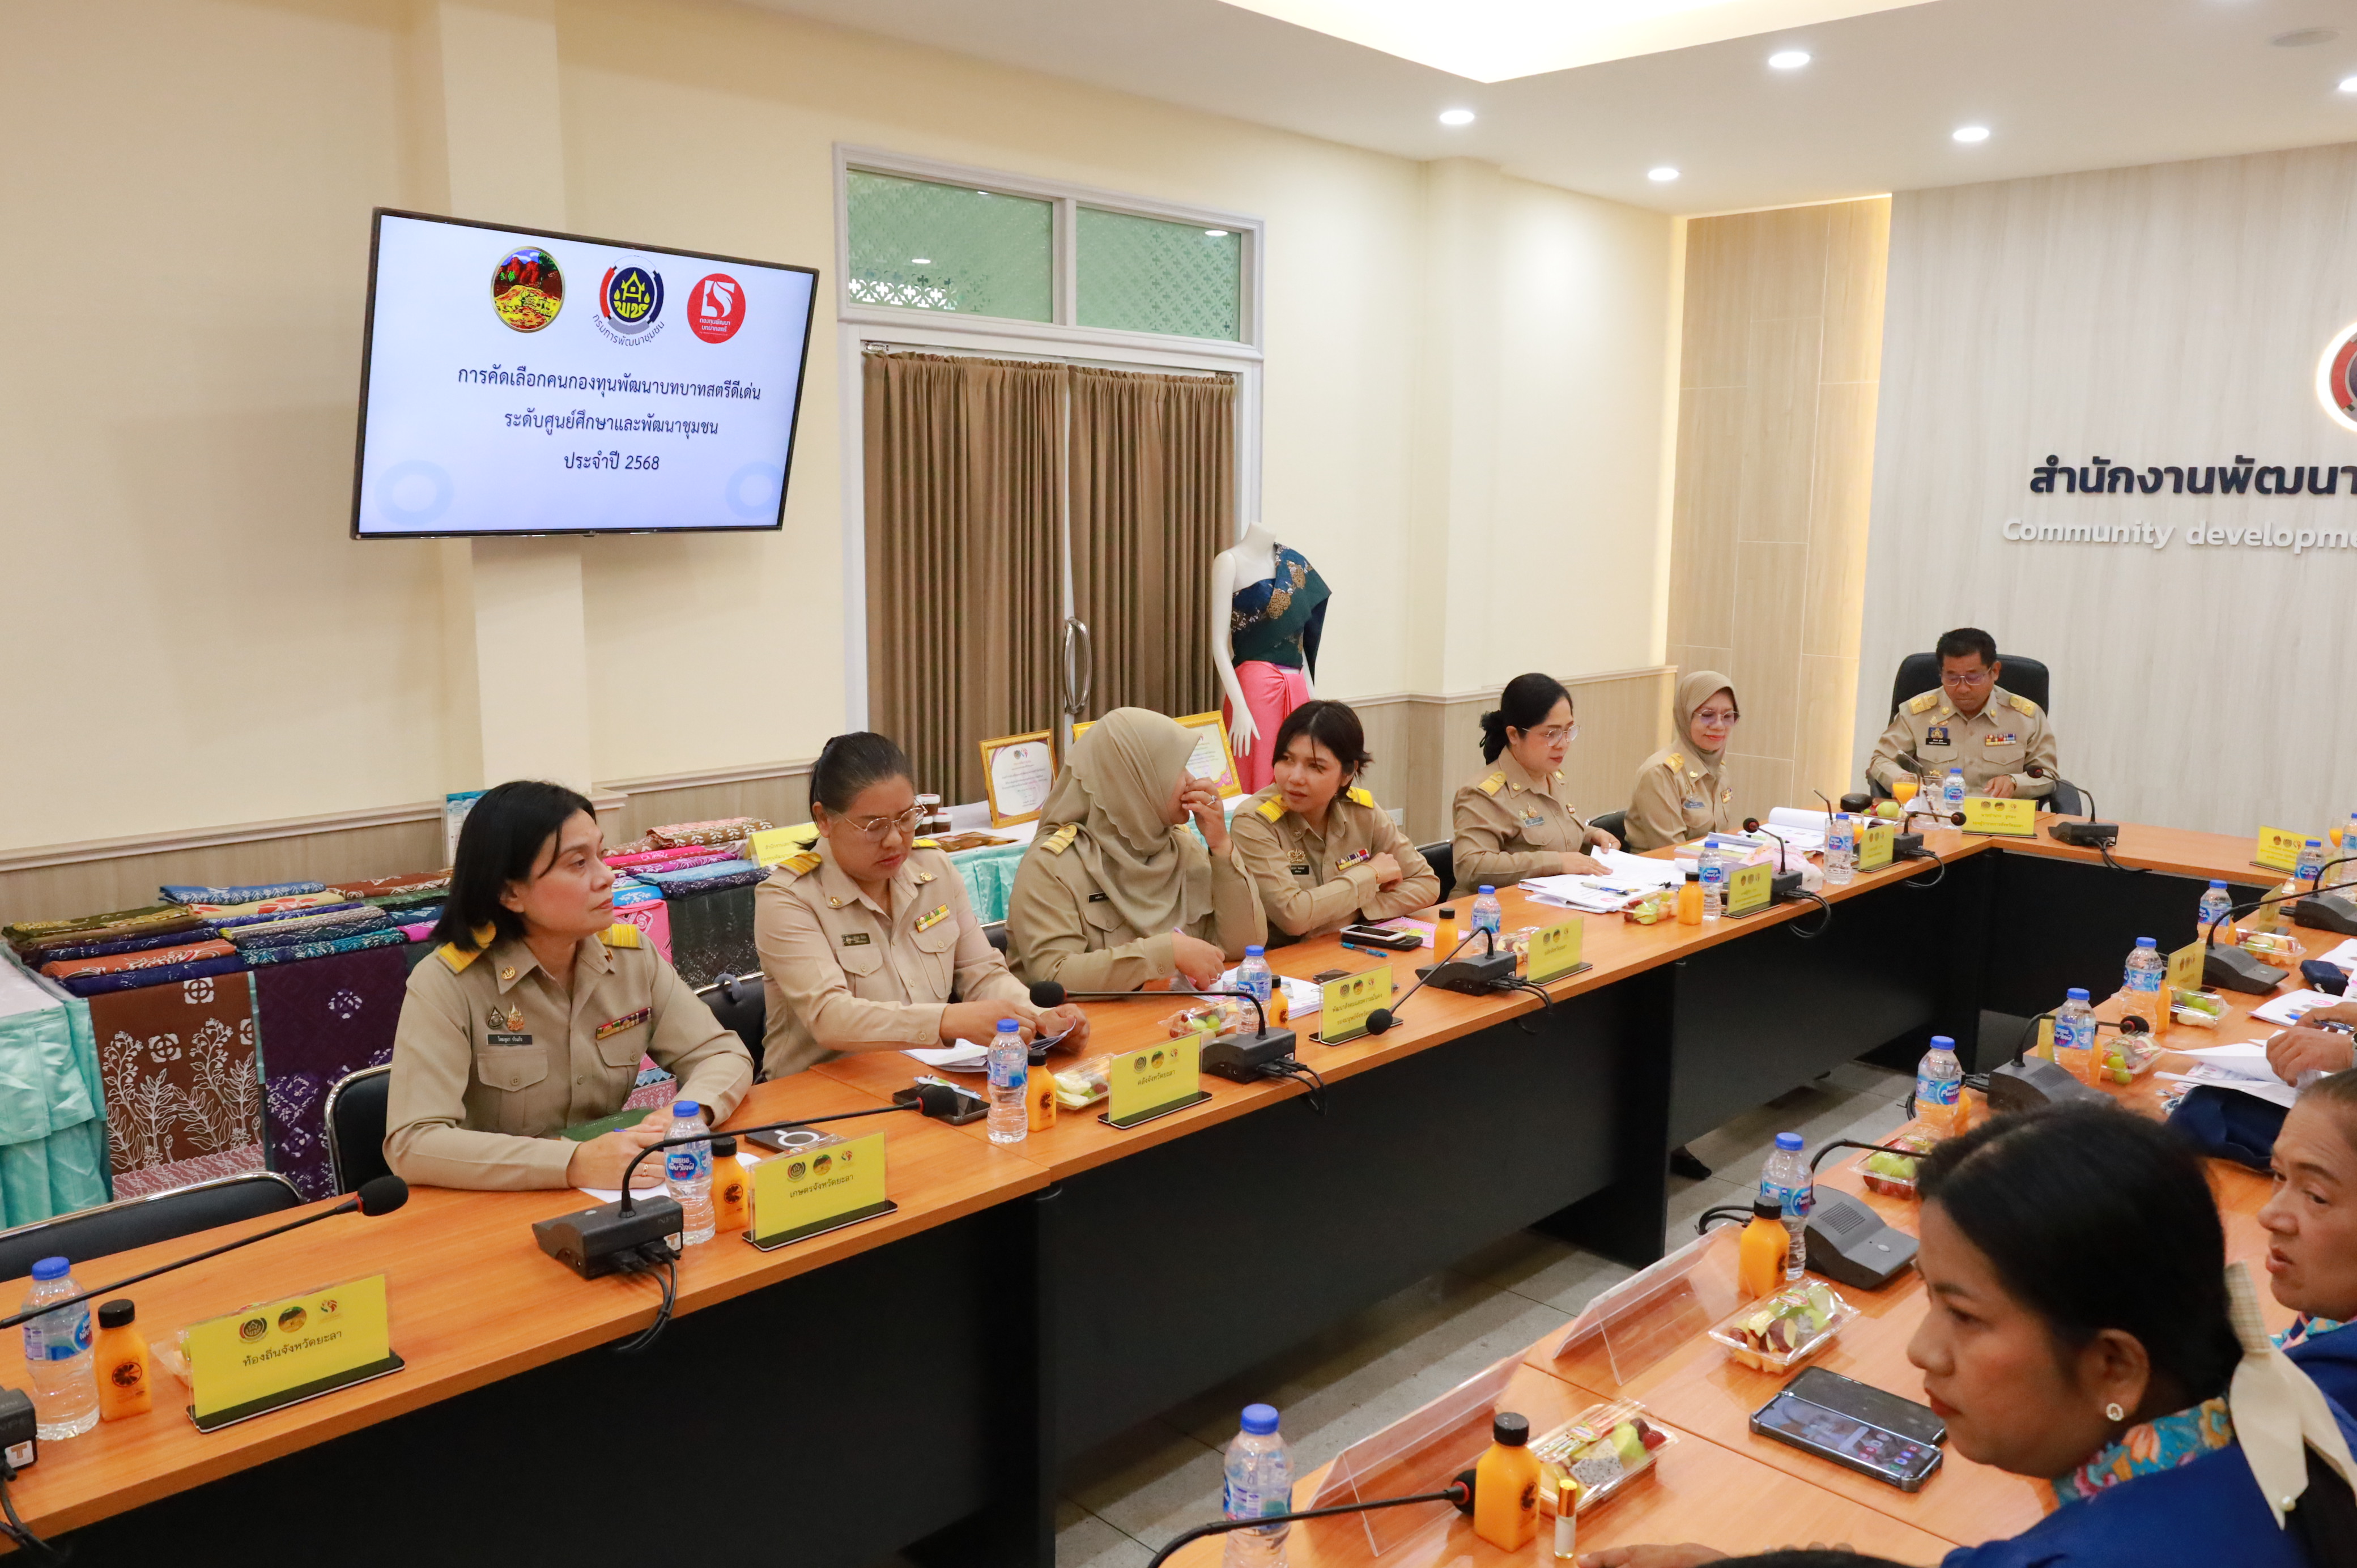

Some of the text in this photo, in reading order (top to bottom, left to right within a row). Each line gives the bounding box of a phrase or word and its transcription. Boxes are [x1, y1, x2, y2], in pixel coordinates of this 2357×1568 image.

[593, 313, 665, 347] กรมการพัฒนาชุมชน
[458, 364, 761, 400] การคัดเลือกคนกองทุนพัฒนาบทบาทสตรีดีเด่น
[505, 407, 718, 440] ระดับศูนย์ศึกษาและพัฒนาชุมชน
[564, 450, 660, 470] ประจำปี 2568
[2002, 518, 2175, 549] Community
[790, 1174, 854, 1198] เกษตรจังหวัดยะลา
[242, 1331, 342, 1367] ท้องถิ่นจังหวัดยะลา
